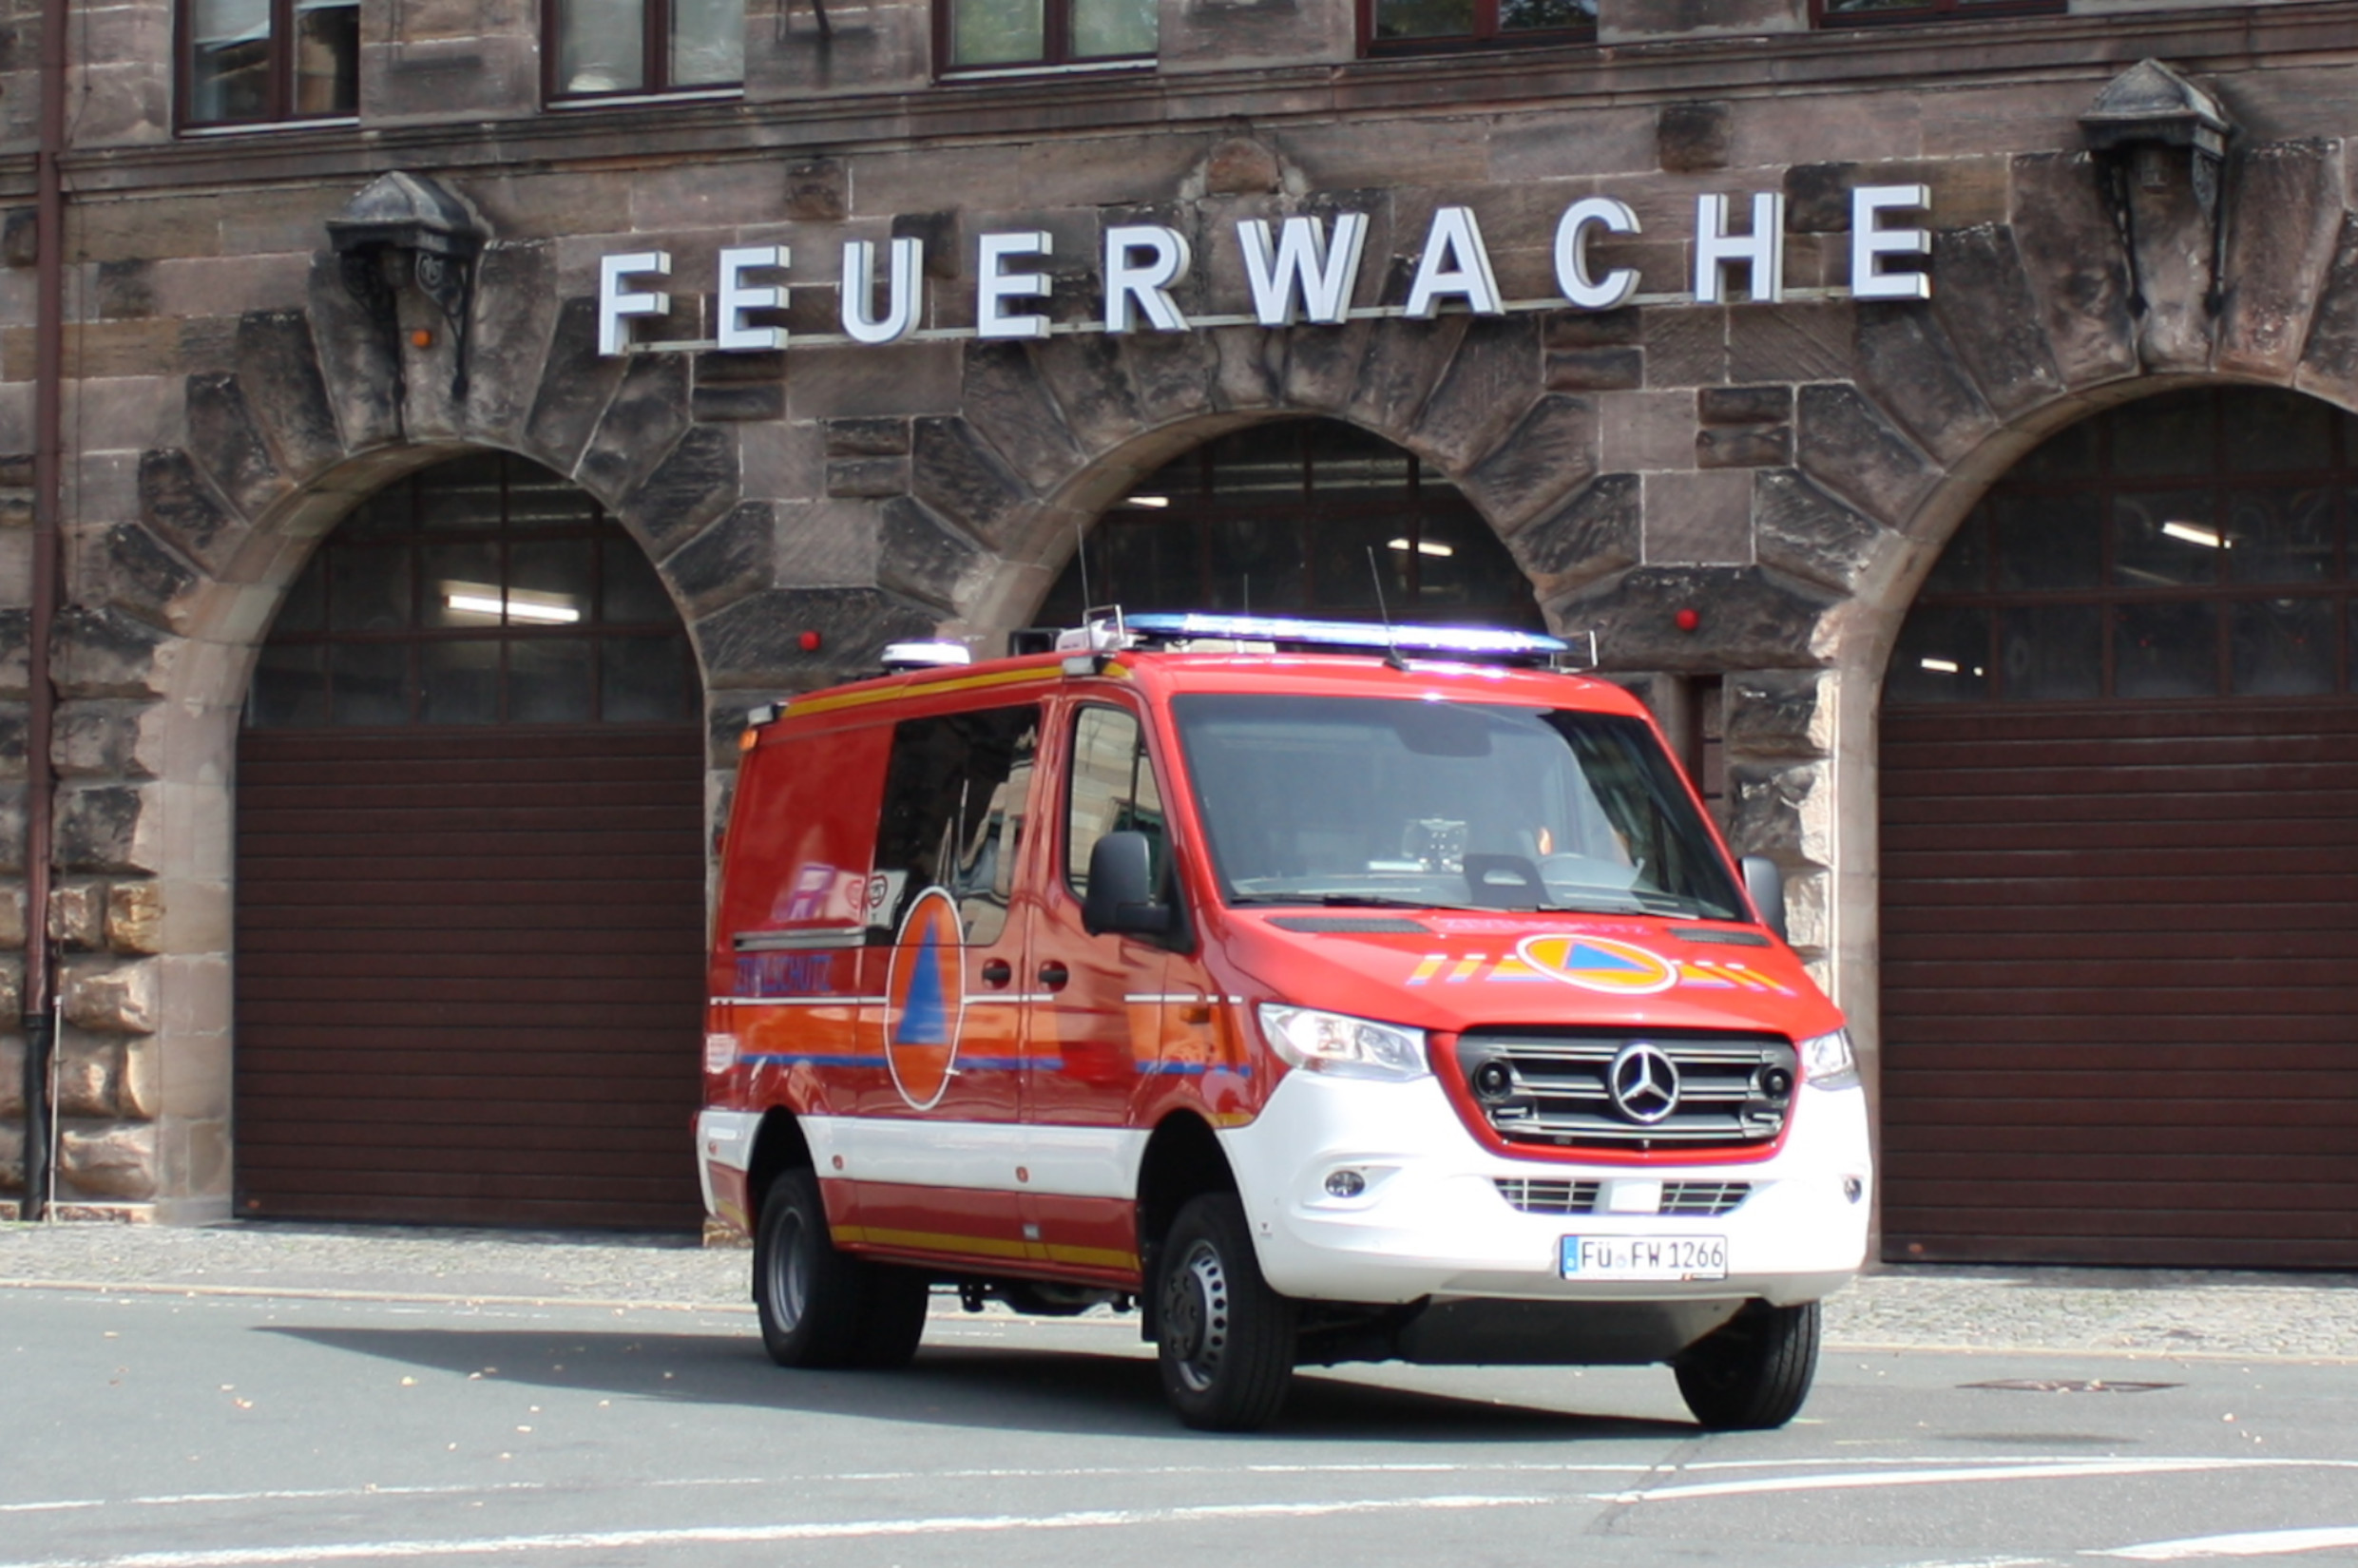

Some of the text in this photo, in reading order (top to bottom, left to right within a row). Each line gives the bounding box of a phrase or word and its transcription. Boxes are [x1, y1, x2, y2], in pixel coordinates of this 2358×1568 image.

[598, 183, 1932, 356] FEUERWACHE
[1582, 1240, 1724, 1269] FÜ FW 1266
